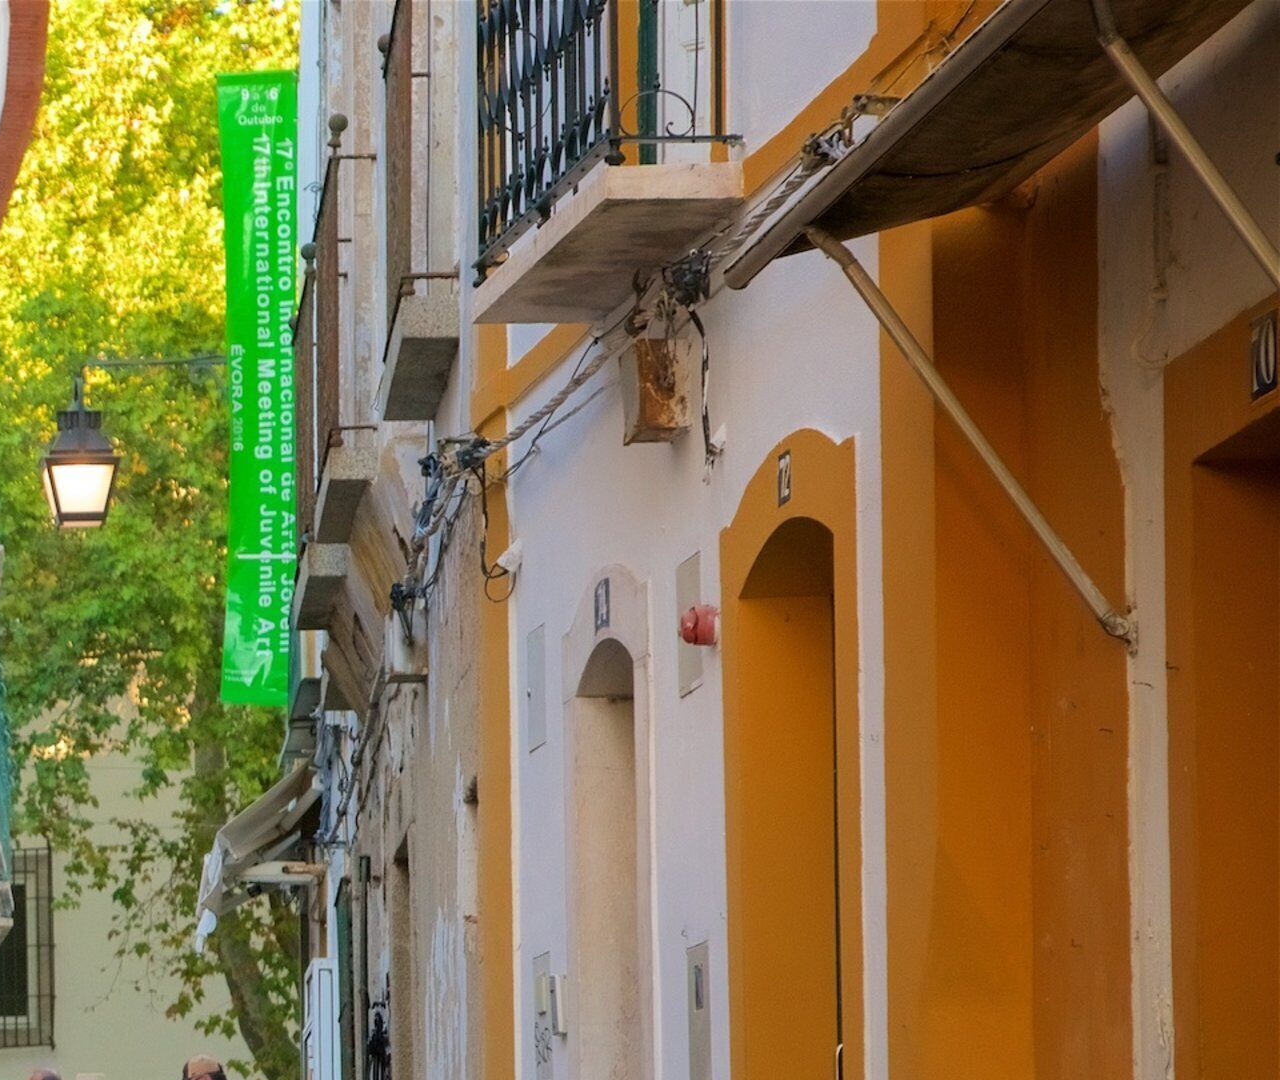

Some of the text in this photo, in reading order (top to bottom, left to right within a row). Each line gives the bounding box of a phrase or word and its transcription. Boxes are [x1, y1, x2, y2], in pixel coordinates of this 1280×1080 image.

[237, 114, 283, 126] Outubro
[253, 181, 275, 348] International
[276, 175, 294, 292] Encontro
[230, 343, 246, 452] ÉVORA 2016
[278, 299, 295, 463] Internacional
[1251, 317, 1275, 392] 70
[253, 358, 277, 460] Meeting
[259, 469, 277, 495] of
[280, 471, 295, 502] de
[779, 453, 791, 499] 72
[259, 503, 278, 607] Juvenile
[256, 617, 276, 657] Art
